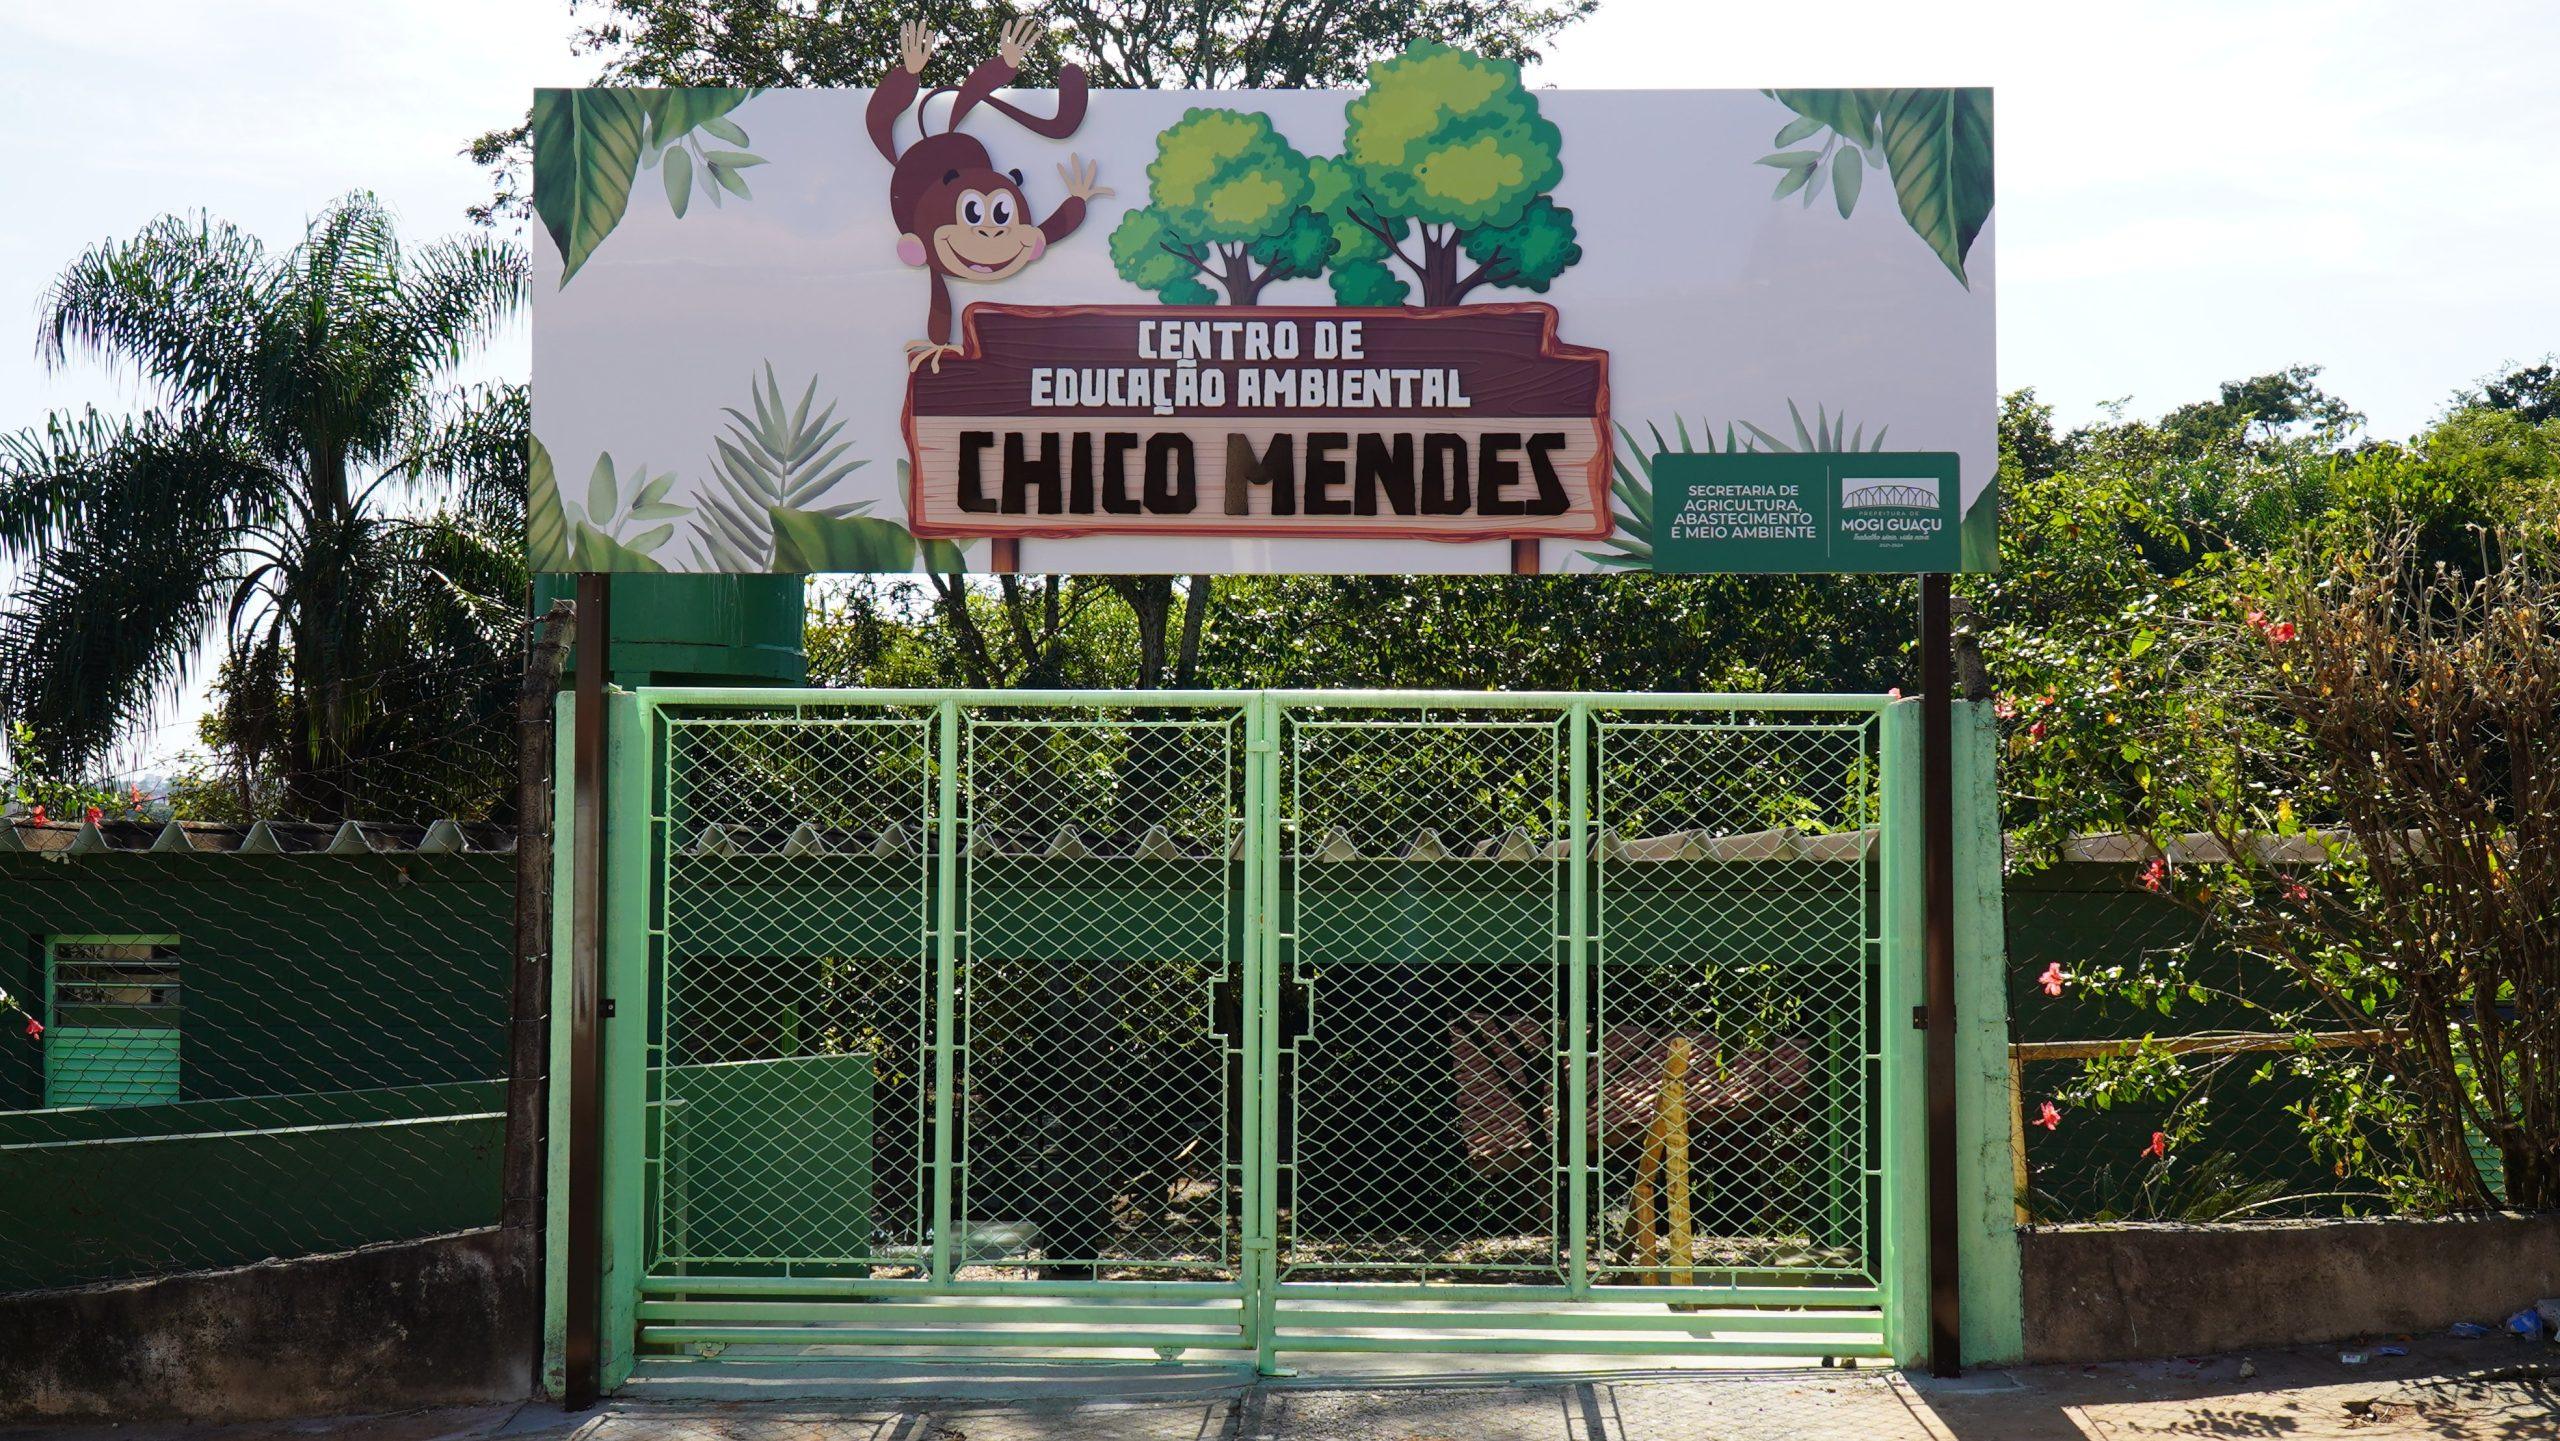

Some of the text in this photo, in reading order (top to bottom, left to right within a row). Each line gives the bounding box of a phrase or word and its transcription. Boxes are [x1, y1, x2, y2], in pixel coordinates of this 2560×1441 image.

[1138, 320, 1365, 360] CENTRO DE
[1031, 358, 1471, 415] EDUCAÇÃO AMBIENTAL
[957, 431, 1571, 517] CHICO MENDES
[1688, 484, 1799, 496] SECRETARIA DE
[1683, 499, 1803, 513] AGRICULTURA,
[1673, 512, 1813, 525] ABASTECIMENTO
[1671, 526, 1817, 538] E MEIO AMBIENTE
[1841, 518, 1942, 535] MOGI GUAÇU
